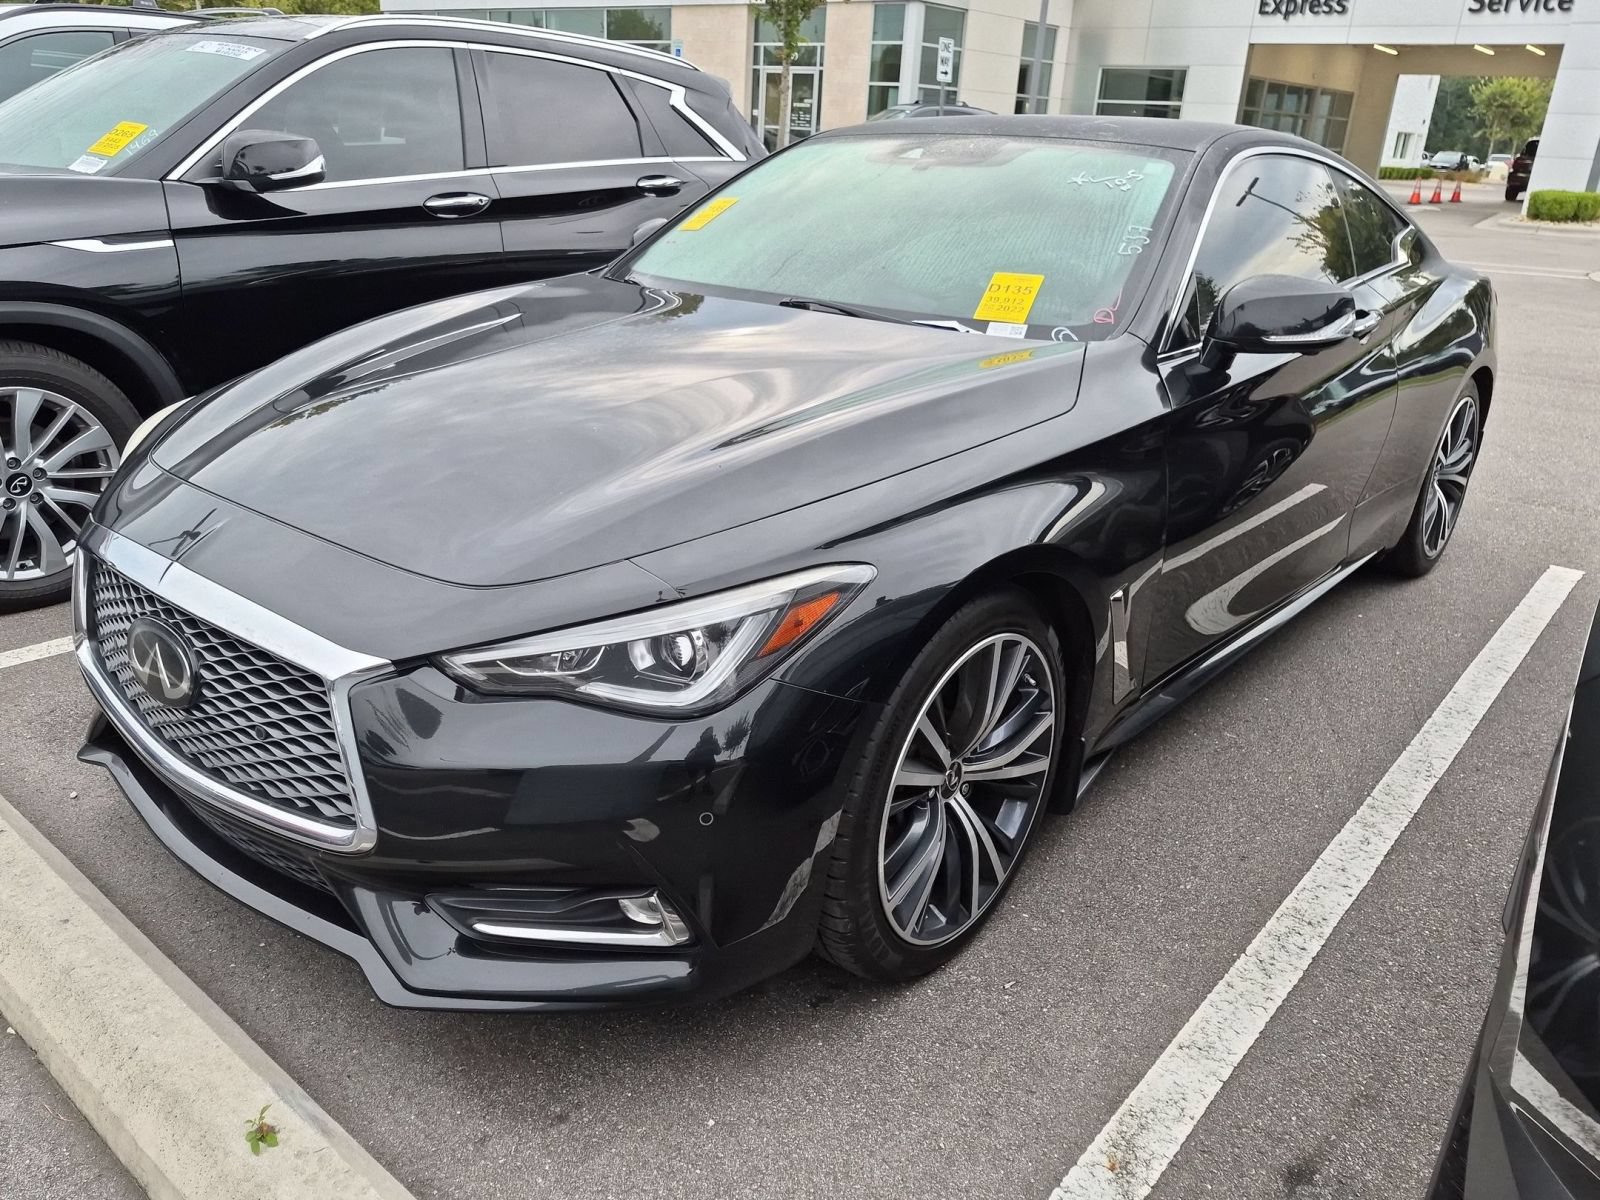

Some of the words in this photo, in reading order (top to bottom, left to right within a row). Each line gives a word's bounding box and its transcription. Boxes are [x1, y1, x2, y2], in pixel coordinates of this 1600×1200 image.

[1258, 0, 1349, 20] Express
[940, 41, 952, 53] ONE
[940, 56, 951, 67] WAY
[988, 283, 1033, 296] D135
[995, 304, 1025, 313] 2022
